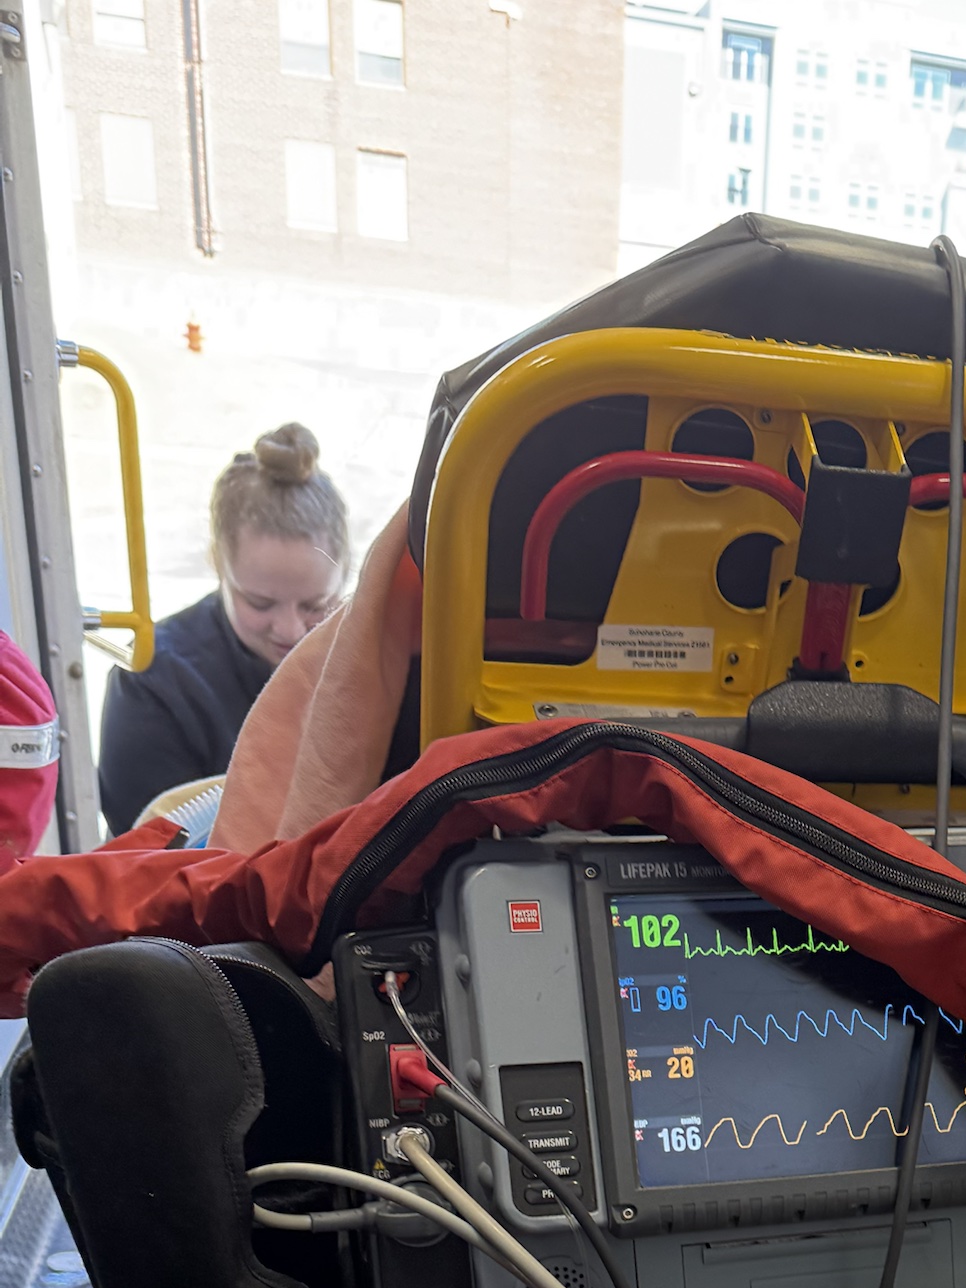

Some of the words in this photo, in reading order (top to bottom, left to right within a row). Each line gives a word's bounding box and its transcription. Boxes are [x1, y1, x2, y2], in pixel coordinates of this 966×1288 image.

[601, 639, 636, 648] Emergency
[638, 639, 661, 647] Medical
[663, 640, 690, 648] Services
[632, 660, 653, 668] Power
[654, 660, 666, 668] Pro
[620, 862, 672, 879] LIFEPAK
[674, 862, 688, 878] 15
[513, 909, 538, 918] PHYSIO
[623, 914, 681, 948] 102
[354, 945, 372, 955] CO2
[656, 985, 687, 1011] 96
[363, 1030, 386, 1042] SpO2
[667, 1056, 694, 1079] 20
[628, 1069, 642, 1082] 34
[529, 1106, 563, 1117] 12-LEAD
[369, 1118, 390, 1128] NIBP
[528, 1137, 570, 1149] TRANSMIT
[658, 1126, 702, 1152] 166
[543, 1160, 560, 1168] ODE
